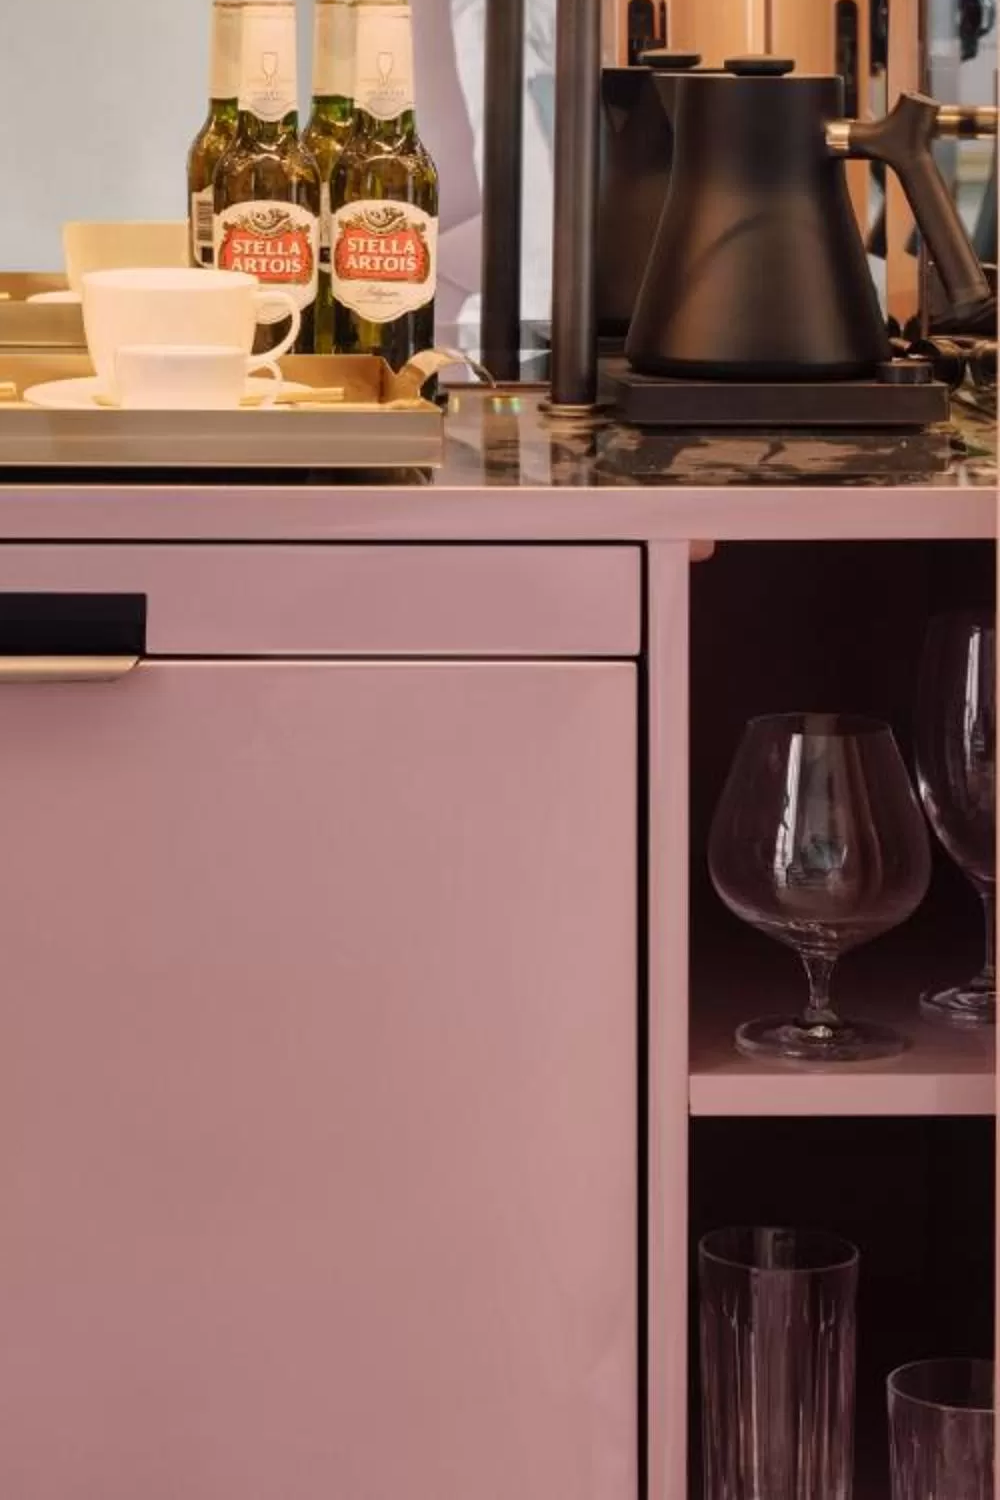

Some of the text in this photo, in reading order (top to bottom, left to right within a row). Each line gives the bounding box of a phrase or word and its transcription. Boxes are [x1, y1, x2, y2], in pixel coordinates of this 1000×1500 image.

[231, 239, 301, 256] STELLA
[347, 237, 416, 255] STELLA
[231, 257, 303, 274] ARTOIS
[346, 255, 418, 273] ARTOIS
